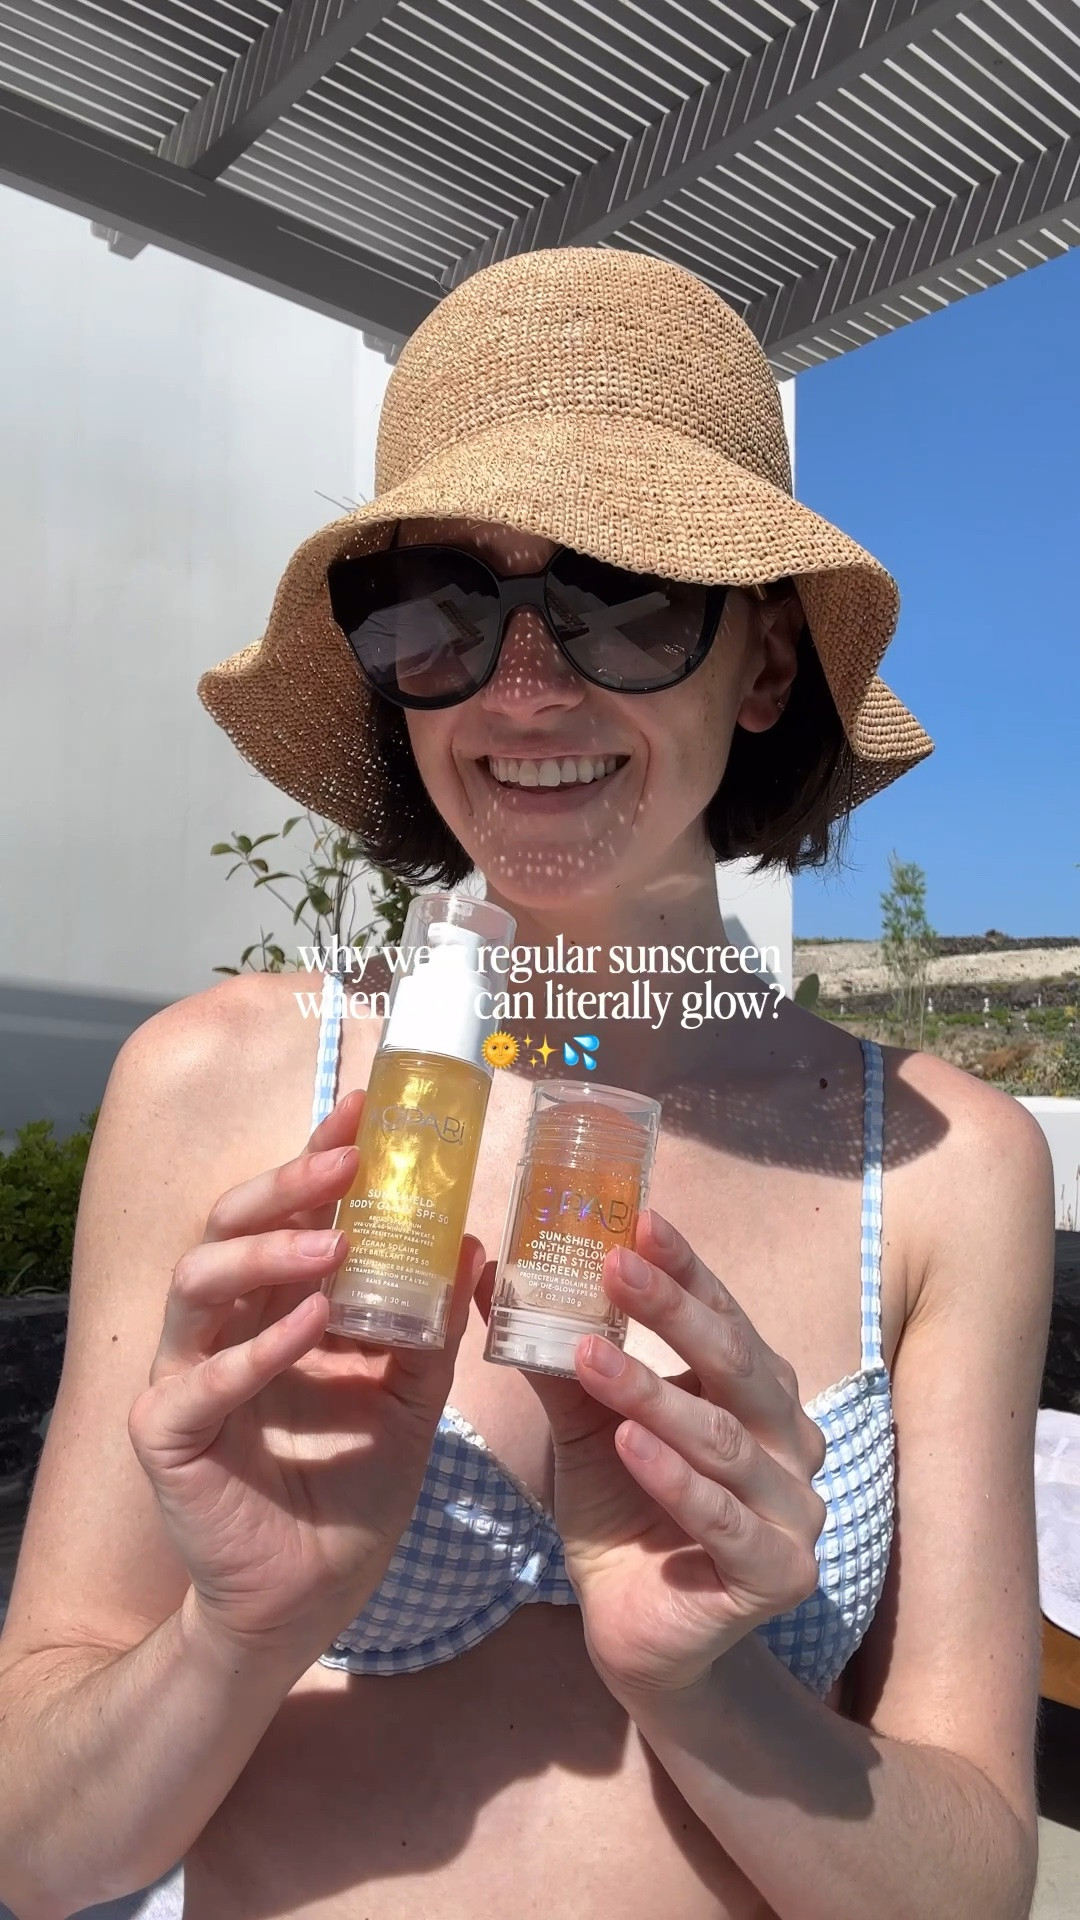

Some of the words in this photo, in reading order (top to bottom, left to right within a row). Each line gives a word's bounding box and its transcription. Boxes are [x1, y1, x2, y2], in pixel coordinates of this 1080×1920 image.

[349, 1199, 375, 1209] BODY
[416, 1208, 436, 1221] SPF
[438, 1214, 449, 1225] 50
[361, 1238, 386, 1248] ÉCRAN
[388, 1242, 419, 1255] SOLAIRE
[539, 1229, 562, 1241] SUN
[565, 1233, 604, 1249] SHIELD
[516, 1258, 579, 1278] SUNSCREEN
[583, 1270, 602, 1282] SPF
[533, 1250, 567, 1265] SHEER
[571, 1256, 603, 1272] STICK
[560, 1278, 588, 1290] SOLAIRE
[566, 1297, 576, 1305] 30
